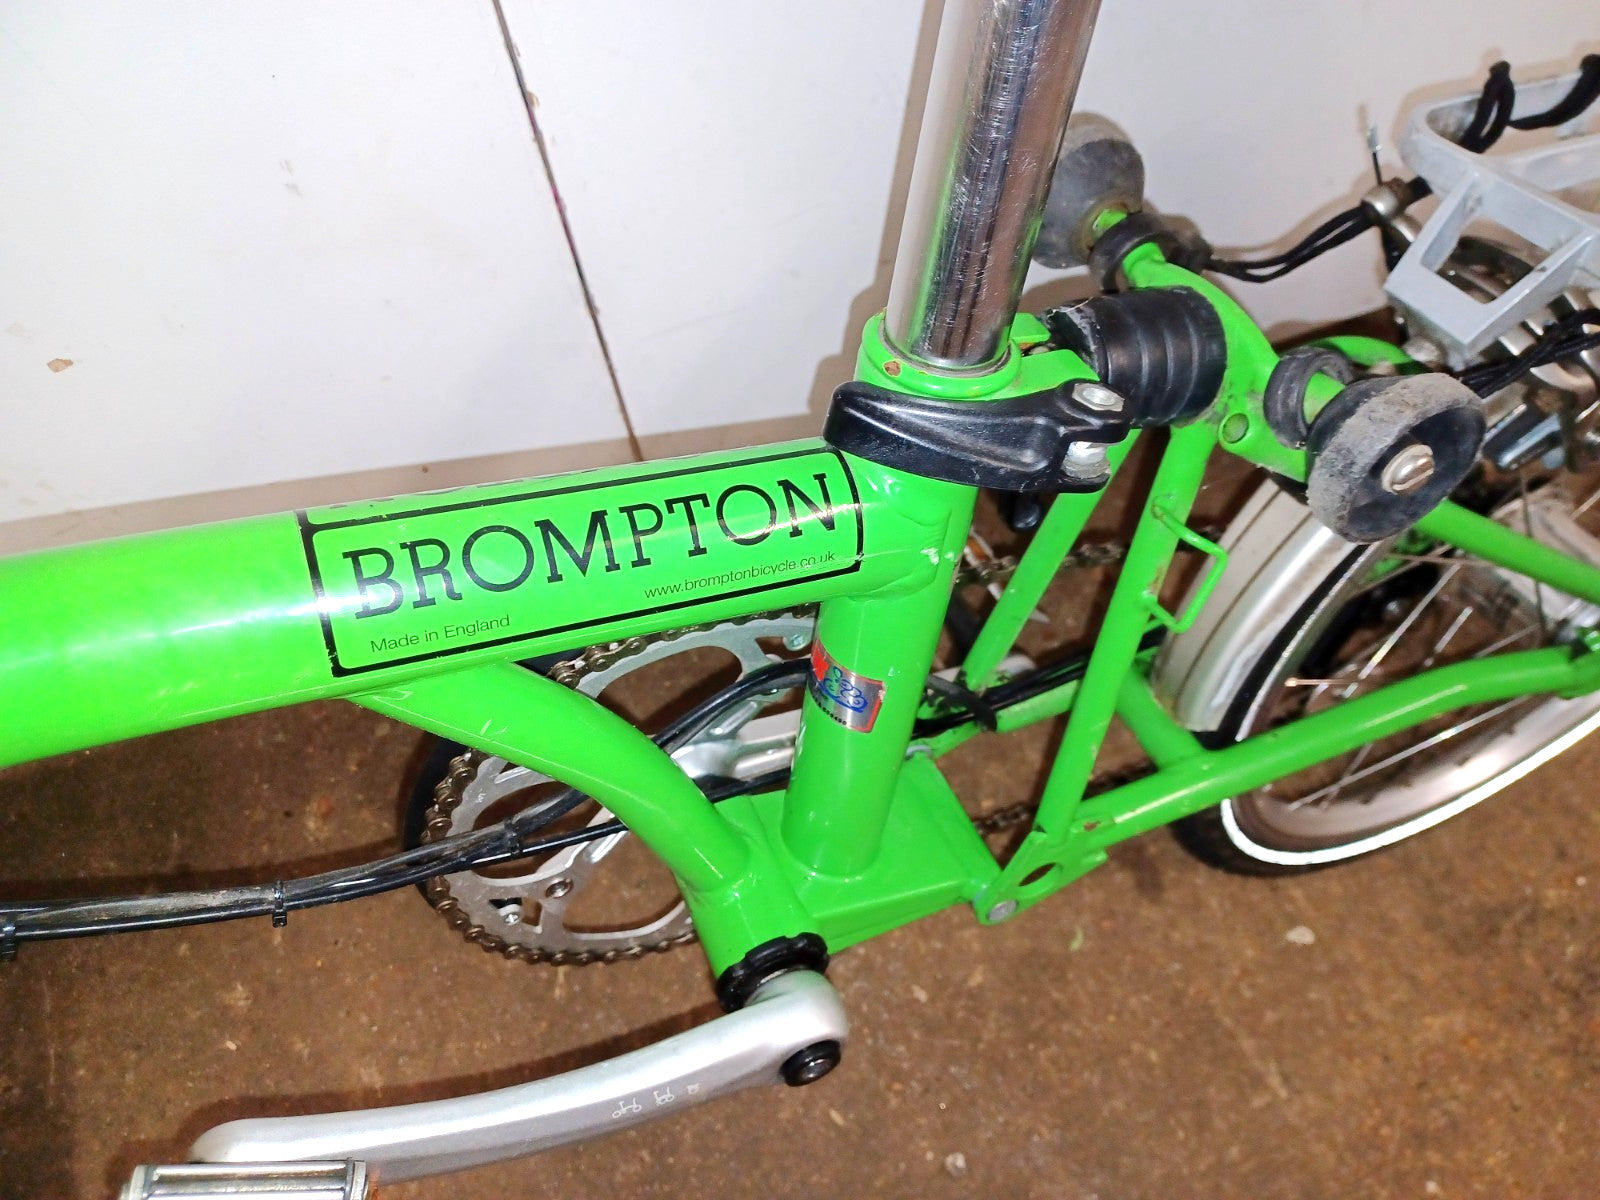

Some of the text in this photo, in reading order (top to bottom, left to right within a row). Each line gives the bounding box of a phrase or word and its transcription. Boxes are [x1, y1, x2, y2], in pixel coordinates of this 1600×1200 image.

[342, 472, 836, 619] BROMPTON
[644, 550, 836, 599] www.bromptonbicycle.co.uk
[370, 613, 511, 653] Made in England
